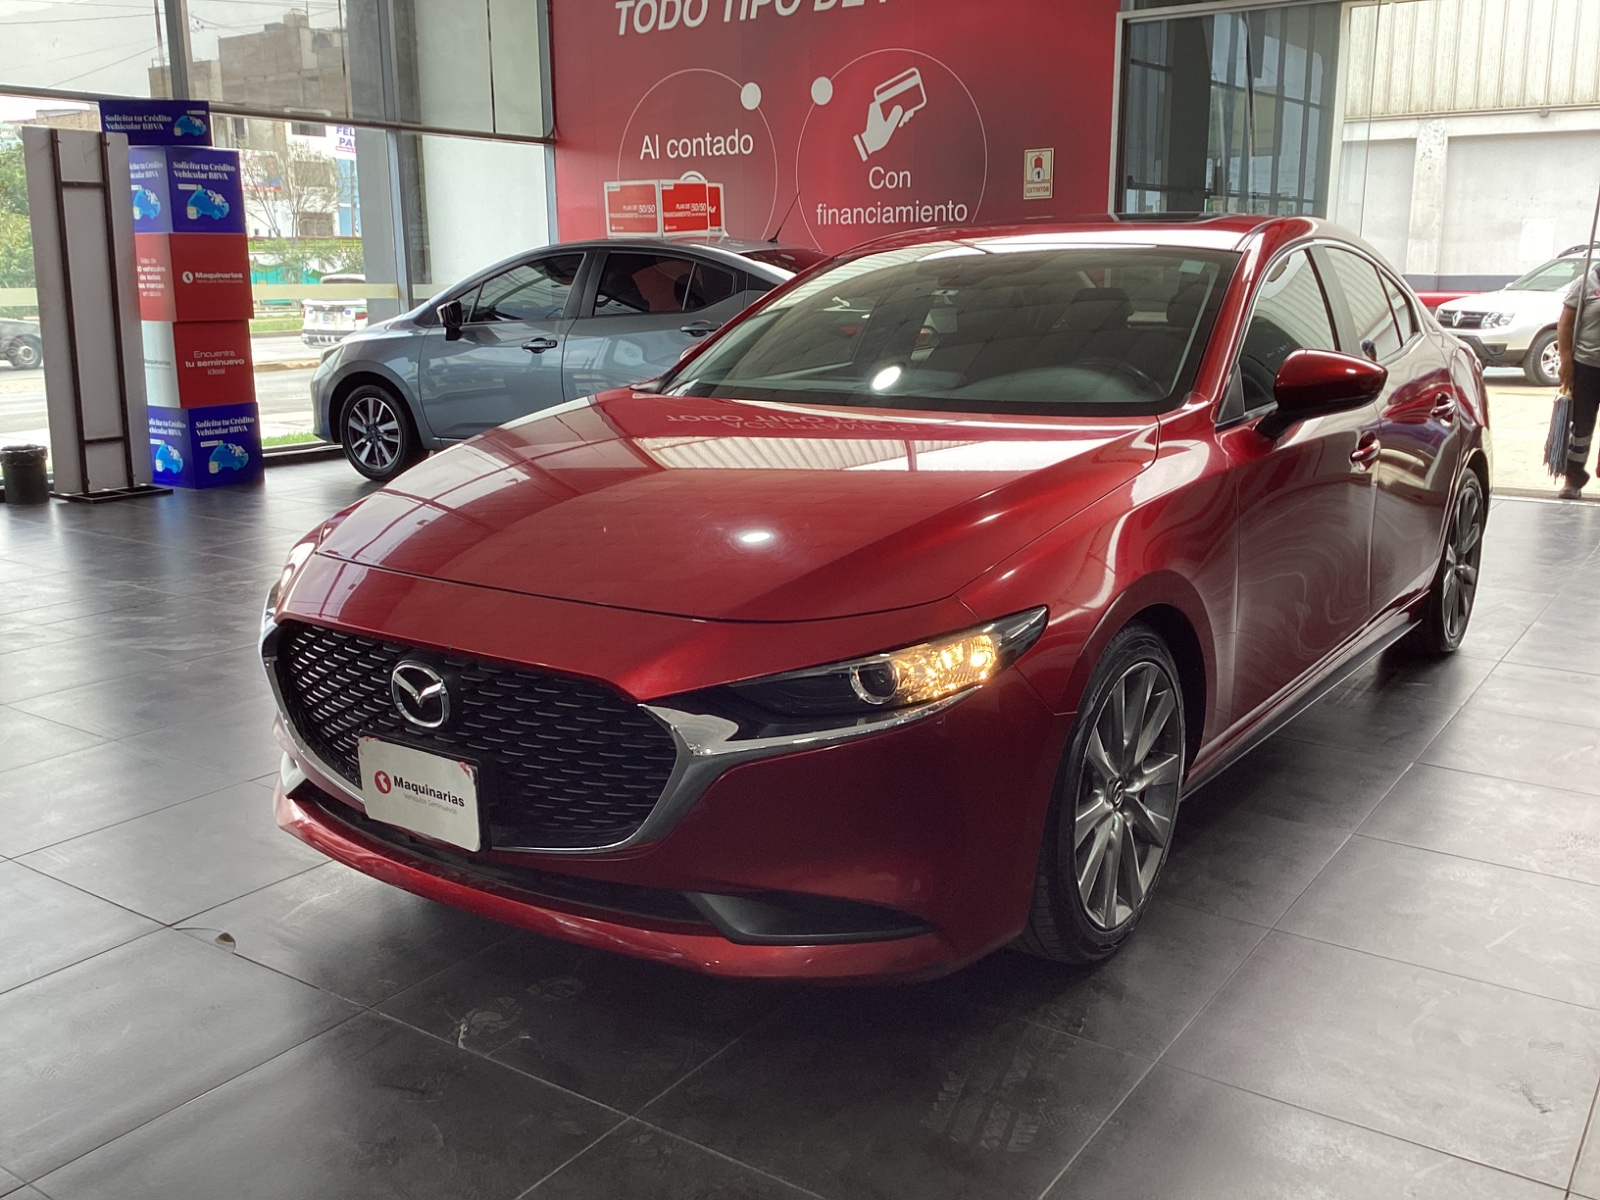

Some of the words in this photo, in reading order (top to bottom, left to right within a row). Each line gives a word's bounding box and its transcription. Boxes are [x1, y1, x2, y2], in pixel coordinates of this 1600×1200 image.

[615, 0, 708, 35] TODO
[105, 114, 133, 122] Solicita
[142, 123, 164, 131] BBVA
[640, 134, 660, 160] Al
[666, 128, 754, 159] contado
[173, 162, 200, 171] Solicita
[174, 170, 208, 179] Vehicular
[209, 171, 228, 180] BBVA
[868, 166, 911, 190] Con
[1035, 170, 1041, 180] 1
[638, 204, 656, 213] 50/50
[691, 203, 707, 212] 50/50
[816, 200, 968, 225] financiamiento
[194, 350, 235, 358] Encuentra
[197, 358, 245, 367] seminuevo
[195, 419, 221, 428] Solicita
[196, 427, 228, 437] Vehicular
[229, 425, 248, 433] BBVA
[393, 776, 465, 807] Maquinarias
